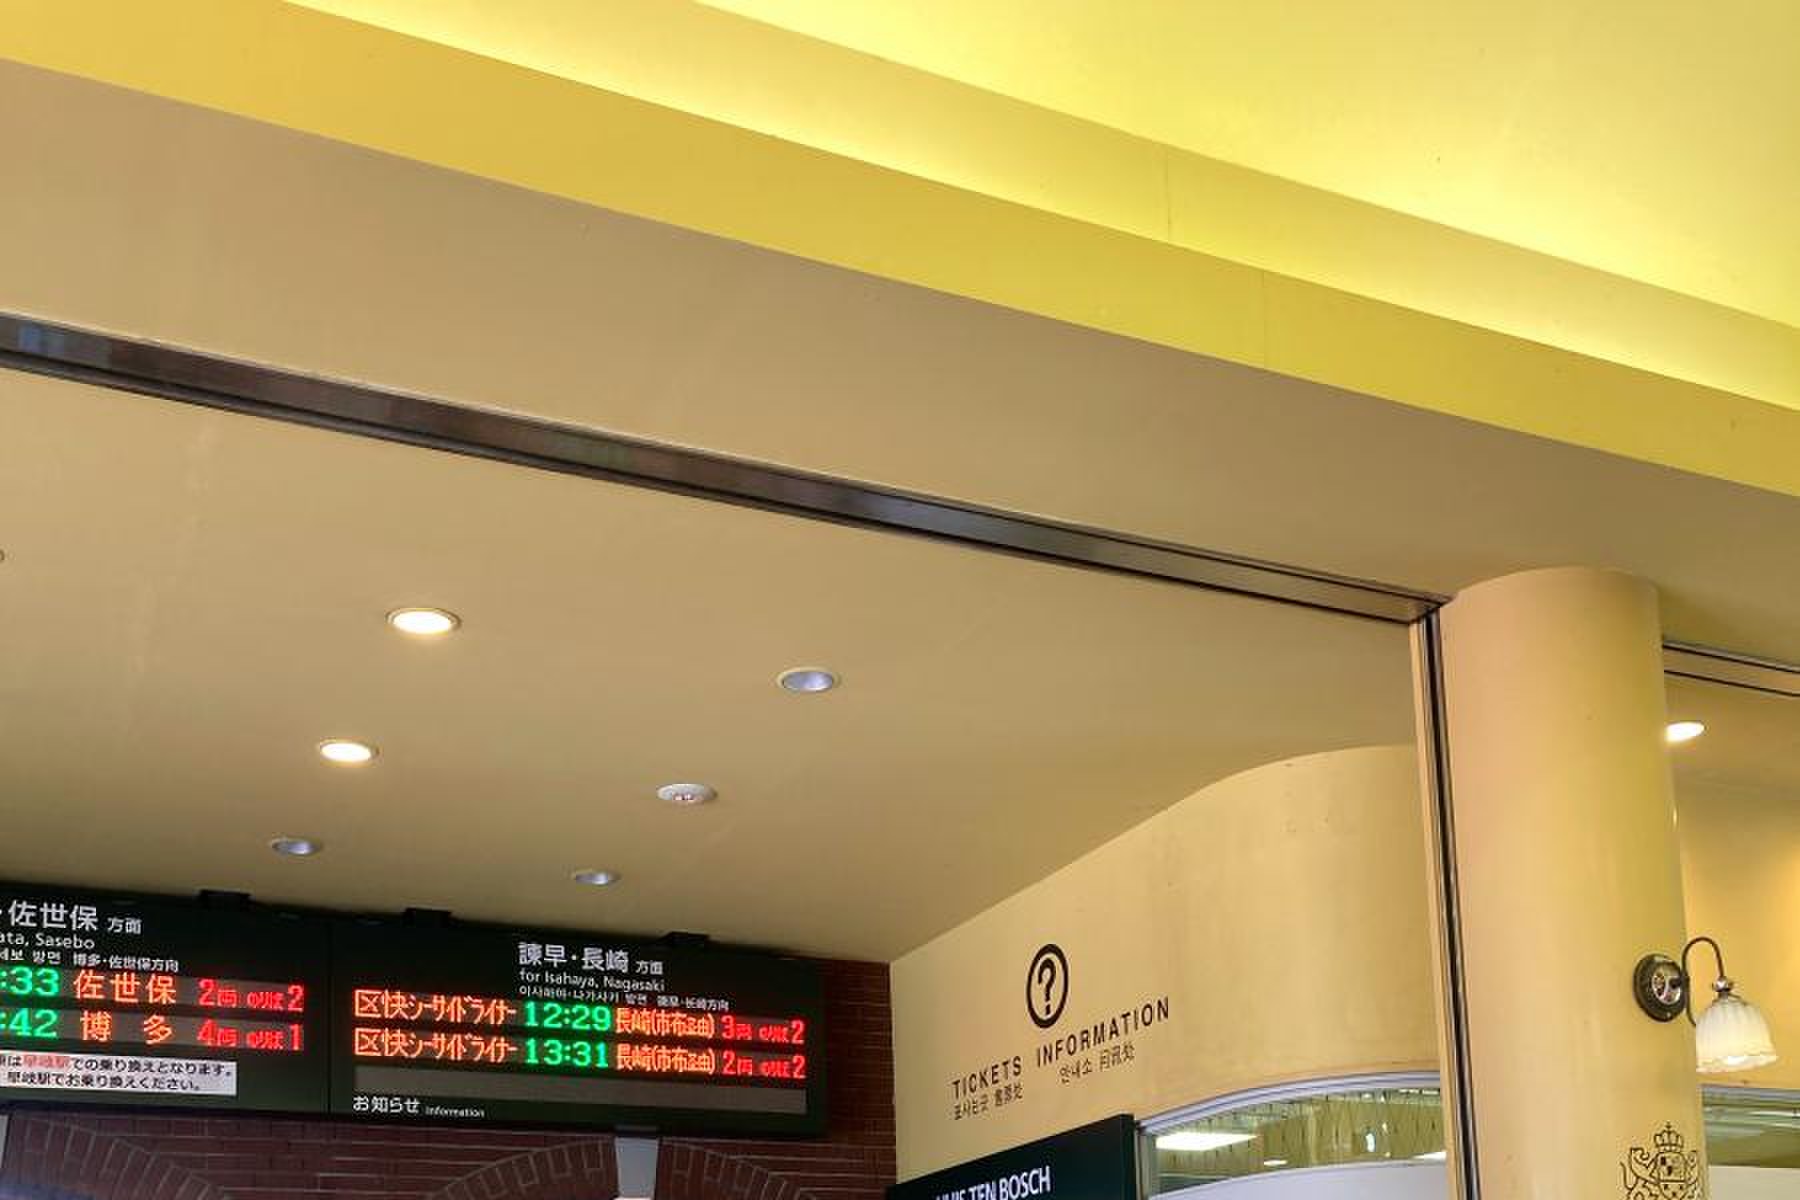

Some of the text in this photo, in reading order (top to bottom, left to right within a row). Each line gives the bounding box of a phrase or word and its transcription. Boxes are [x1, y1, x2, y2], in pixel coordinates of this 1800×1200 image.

[107, 917, 142, 934] 方面
[35, 933, 95, 949] Sasebo
[636, 960, 663, 975] 方面
[73, 971, 176, 1005] 佐世保
[520, 968, 540, 983] for
[603, 976, 664, 993] Nagasaki
[525, 1000, 612, 1031] 12:29
[526, 1037, 609, 1067] 13:31
[952, 997, 1169, 1099] TICKETS INFORMATION
[353, 1095, 420, 1115] お知らせ
